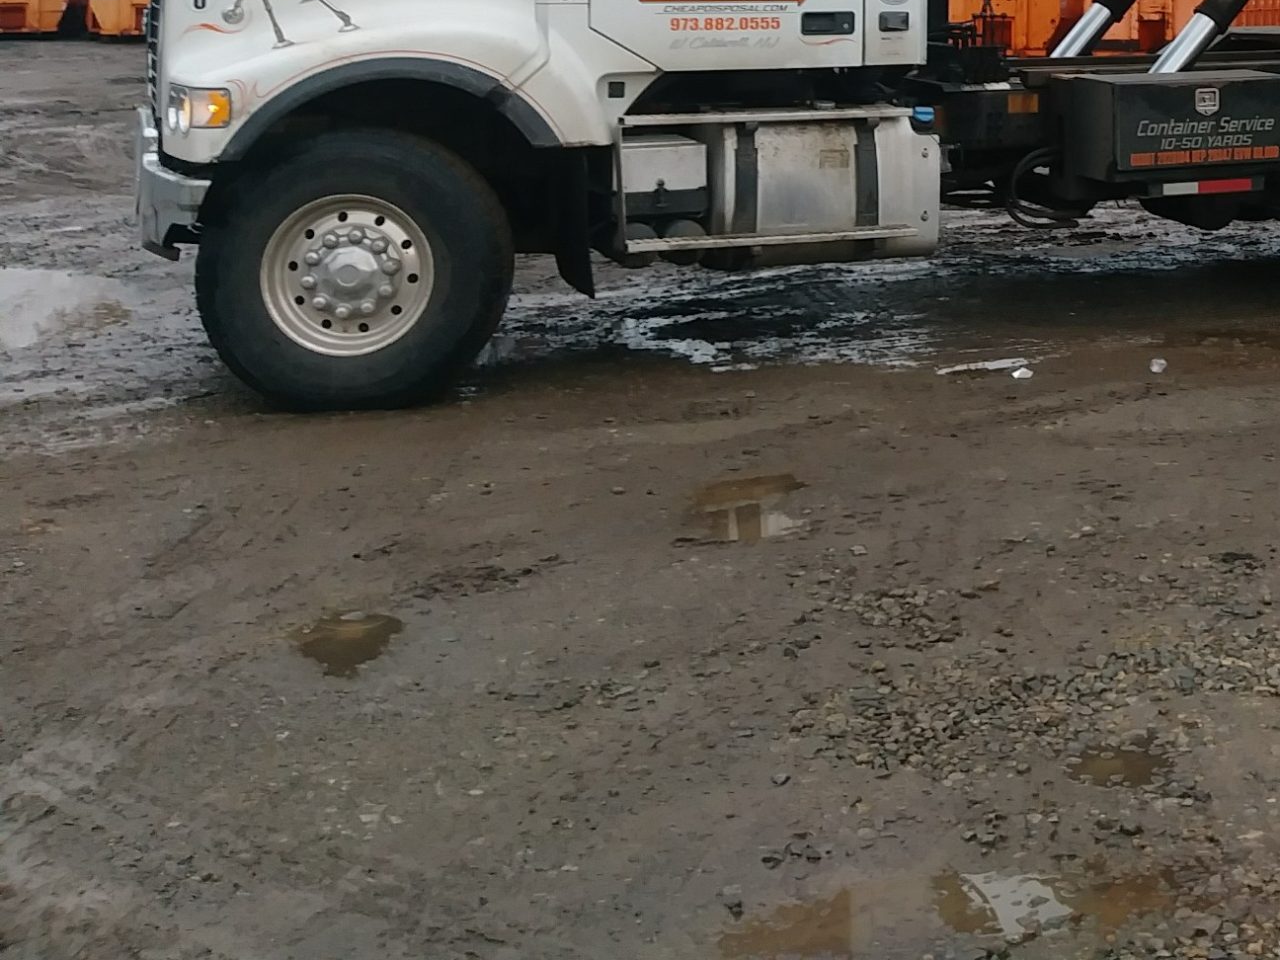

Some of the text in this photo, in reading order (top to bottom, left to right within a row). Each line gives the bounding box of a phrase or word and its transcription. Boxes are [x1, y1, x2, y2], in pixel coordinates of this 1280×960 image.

[664, 4, 788, 13] CHEAPDISPOSAL.COM
[670, 17, 781, 31] 973.882.0555
[1137, 116, 1275, 137] Container Service
[1160, 134, 1253, 150] 10-50 YARDS
